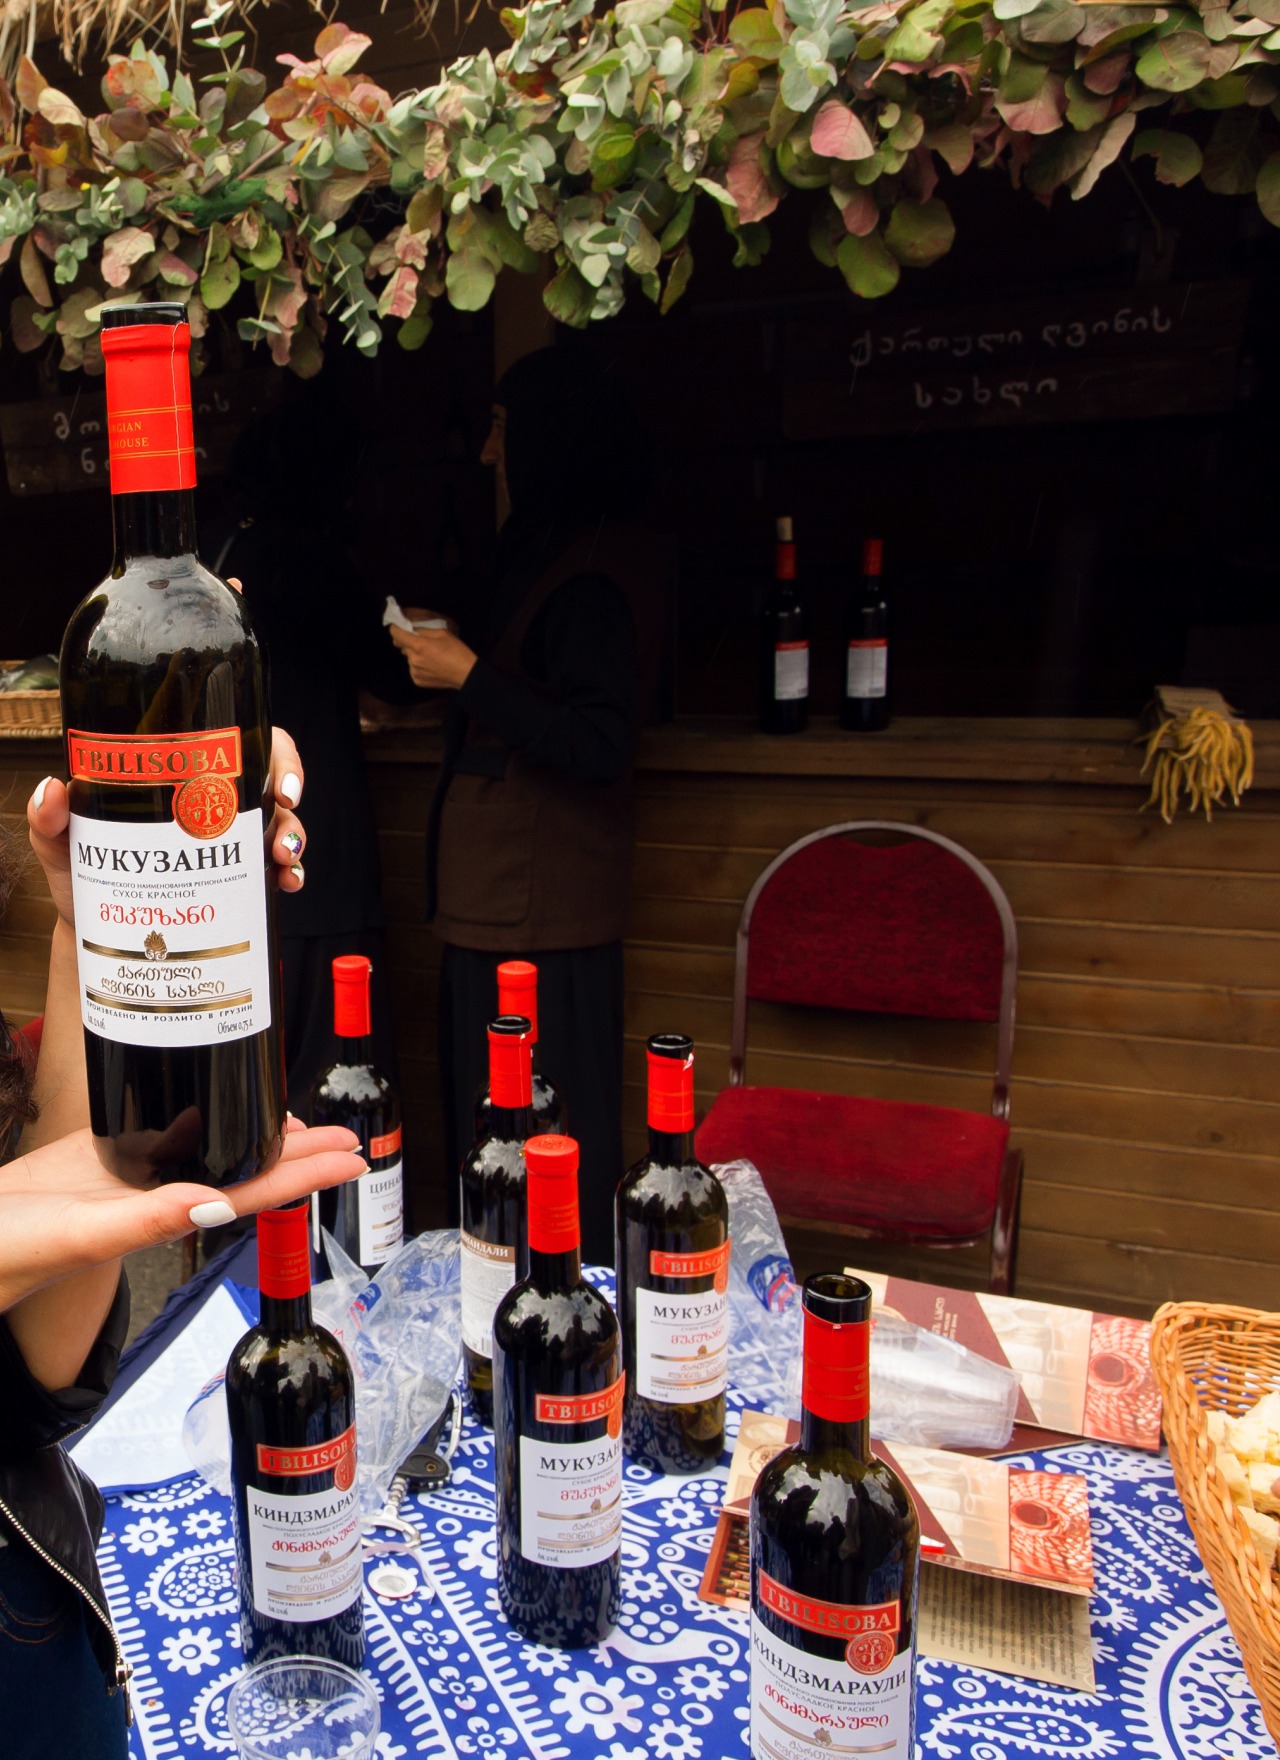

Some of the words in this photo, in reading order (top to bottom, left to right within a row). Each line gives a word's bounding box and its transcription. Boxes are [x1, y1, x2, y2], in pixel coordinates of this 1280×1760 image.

[850, 329, 1021, 366] ქართული
[914, 376, 1058, 408] სახლი
[76, 747, 231, 775] TBILISOBA
[77, 841, 242, 874] МУКУЗАНИ
[112, 888, 144, 899] СУХОЕ
[147, 889, 197, 899] КРАСНОЕ
[137, 881, 193, 890] НАИМЕНОВАНИЯ
[194, 878, 223, 887] РЕГИОНА
[99, 902, 215, 926] მუკუზანი
[86, 1000, 136, 1020] ПРОИЗВЕДЕНО
[154, 1013, 202, 1022] РОЗЛИТО
[219, 1004, 253, 1018] ГРУЗИИ
[653, 1297, 727, 1319] МУКУЗАН
[545, 1384, 623, 1419] TBILISO
[540, 1442, 621, 1472] МУКУЗАН
[765, 1584, 892, 1631] TBILISOBA
[753, 1632, 907, 1696] КИНДЗМАРАУЛИ
[837, 1705, 875, 1713] КРАСНОЕ
